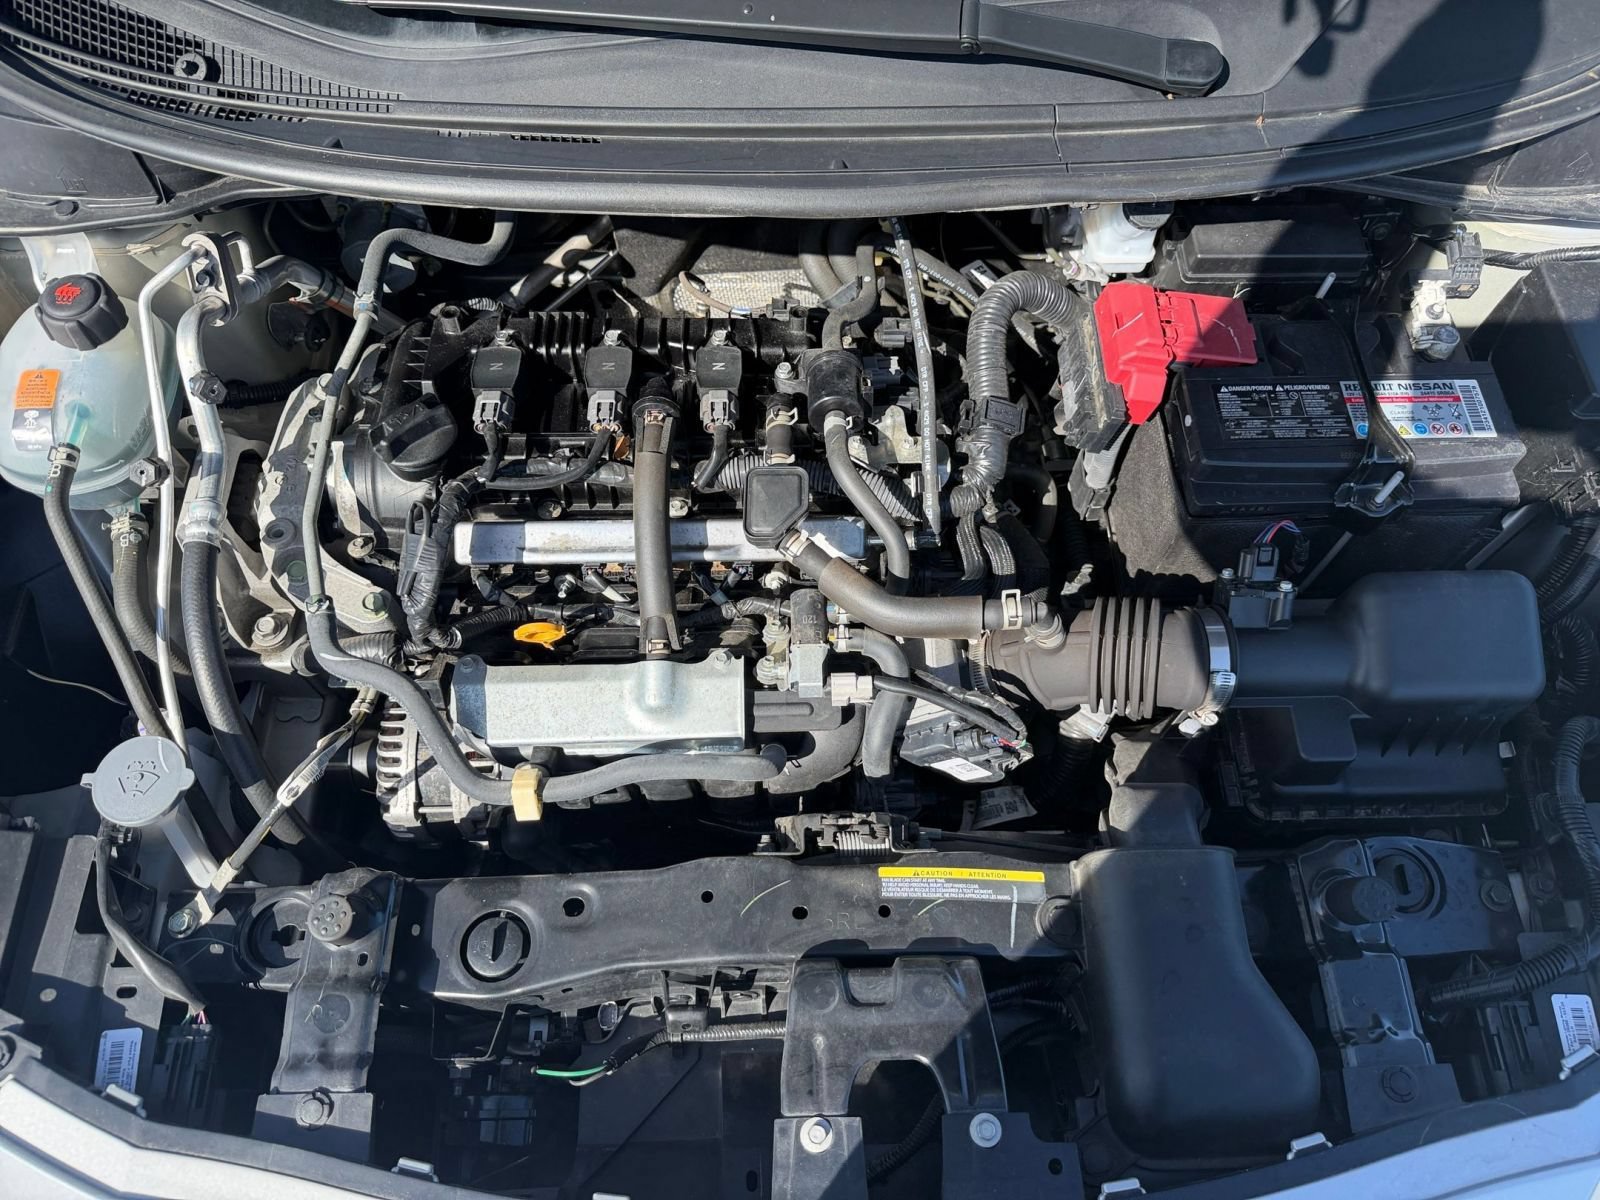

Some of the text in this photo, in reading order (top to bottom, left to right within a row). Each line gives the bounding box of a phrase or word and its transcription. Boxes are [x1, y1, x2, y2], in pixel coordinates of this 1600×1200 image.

[1397, 382, 1453, 391] NISSAN
[49, 463, 61, 477] B
[802, 614, 817, 624] 120
[968, 871, 1007, 879] ATTENTION
